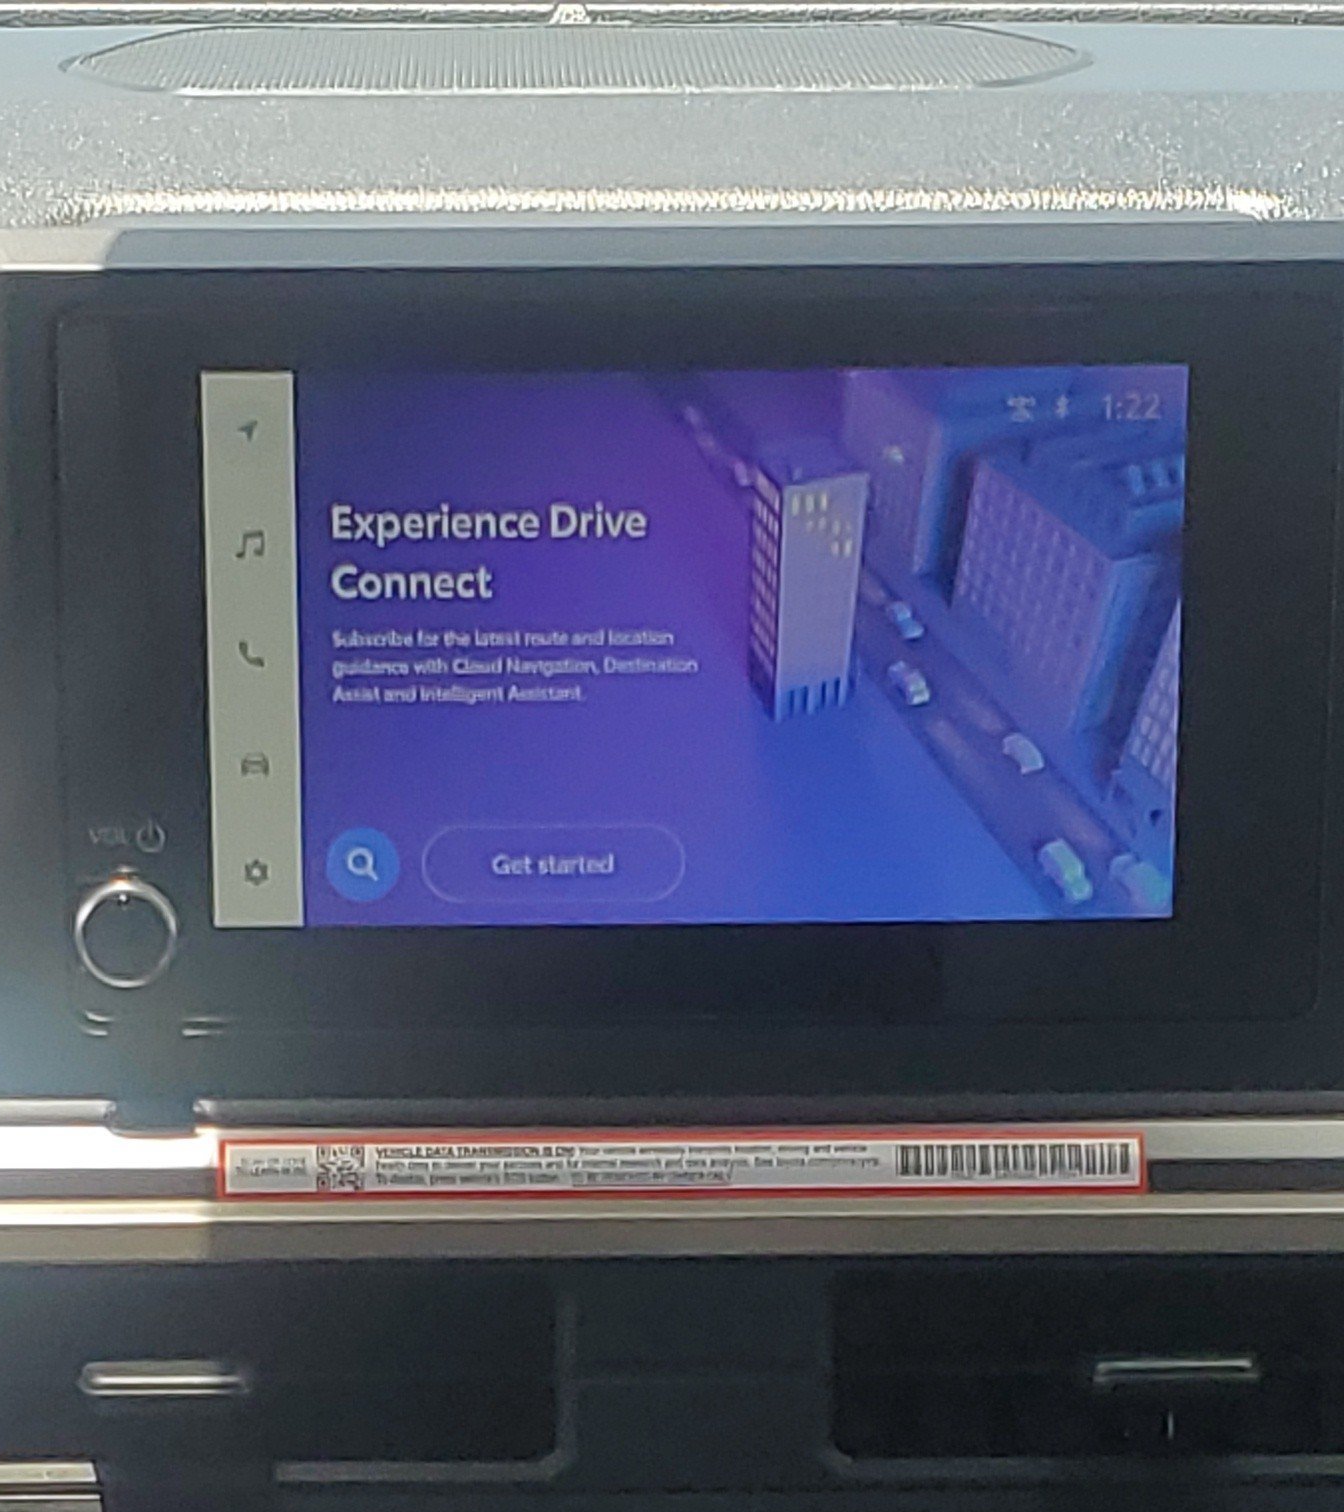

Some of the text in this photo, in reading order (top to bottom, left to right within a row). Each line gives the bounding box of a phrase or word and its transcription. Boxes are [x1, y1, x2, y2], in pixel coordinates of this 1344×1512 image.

[1103, 394, 1161, 420] 1:22
[330, 501, 648, 547] Experience Drive
[331, 564, 493, 602] Connect
[332, 629, 674, 648] Subscribe for the latest route and location
[332, 656, 699, 679] guidance with Cloud Navigation, Destination
[332, 686, 381, 703] Assist
[384, 686, 417, 703] and
[420, 685, 505, 706] Intelligent
[89, 827, 128, 845] VOL
[492, 854, 614, 875] Get started
